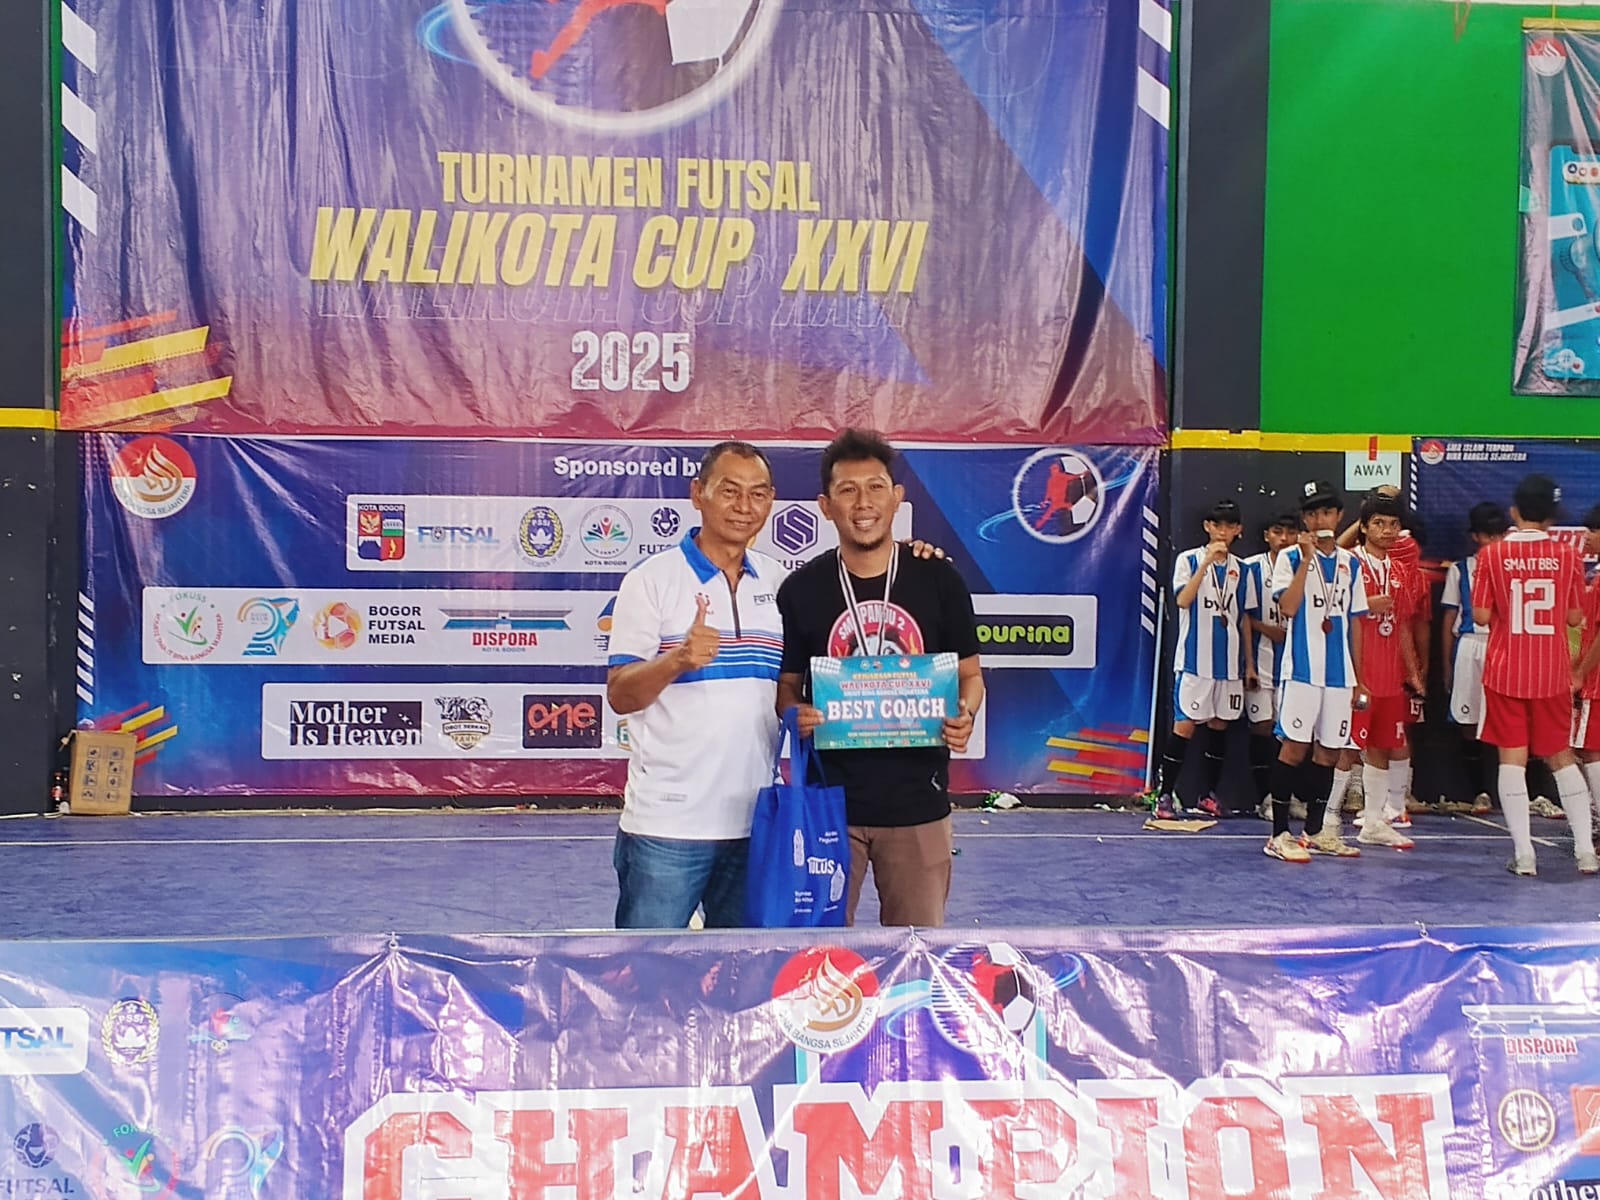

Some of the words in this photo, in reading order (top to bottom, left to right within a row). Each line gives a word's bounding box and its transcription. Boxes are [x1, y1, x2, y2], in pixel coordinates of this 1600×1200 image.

[437, 151, 662, 208] TURNAMEN
[677, 157, 820, 212] FUTSAL
[310, 206, 617, 288] WALIKOTA
[632, 214, 755, 290] CUP
[781, 218, 929, 293] XXVI
[571, 332, 691, 393] 2025
[554, 456, 677, 480] Sponsored
[1353, 464, 1392, 476] AWAY
[358, 504, 378, 512] KOTA
[378, 504, 405, 512] BOGOR
[1503, 557, 1525, 571] SMA
[1527, 557, 1538, 571] IT
[1538, 557, 1560, 571] BBS
[368, 605, 422, 617] BOGOR
[1510, 578, 1556, 635] 12
[368, 620, 426, 631] FUTSAL
[897, 616, 907, 632] 2
[368, 634, 416, 645] MEDIA
[472, 632, 538, 647] DISPORA
[827, 700, 876, 721] BEST
[880, 698, 946, 719] COACH
[1229, 694, 1242, 711] 10
[290, 702, 389, 725] Mother
[527, 702, 597, 730] one
[295, 724, 319, 746] Is
[326, 724, 422, 746] Heaven
[528, 728, 598, 737] SPIRIT
[1338, 719, 1348, 738] 8
[118, 1013, 144, 1023] PSSI
[792, 1028, 832, 1049] BANGSA
[1506, 1037, 1577, 1055] DISPORA
[345, 1074, 1450, 1200] CHAMPION
